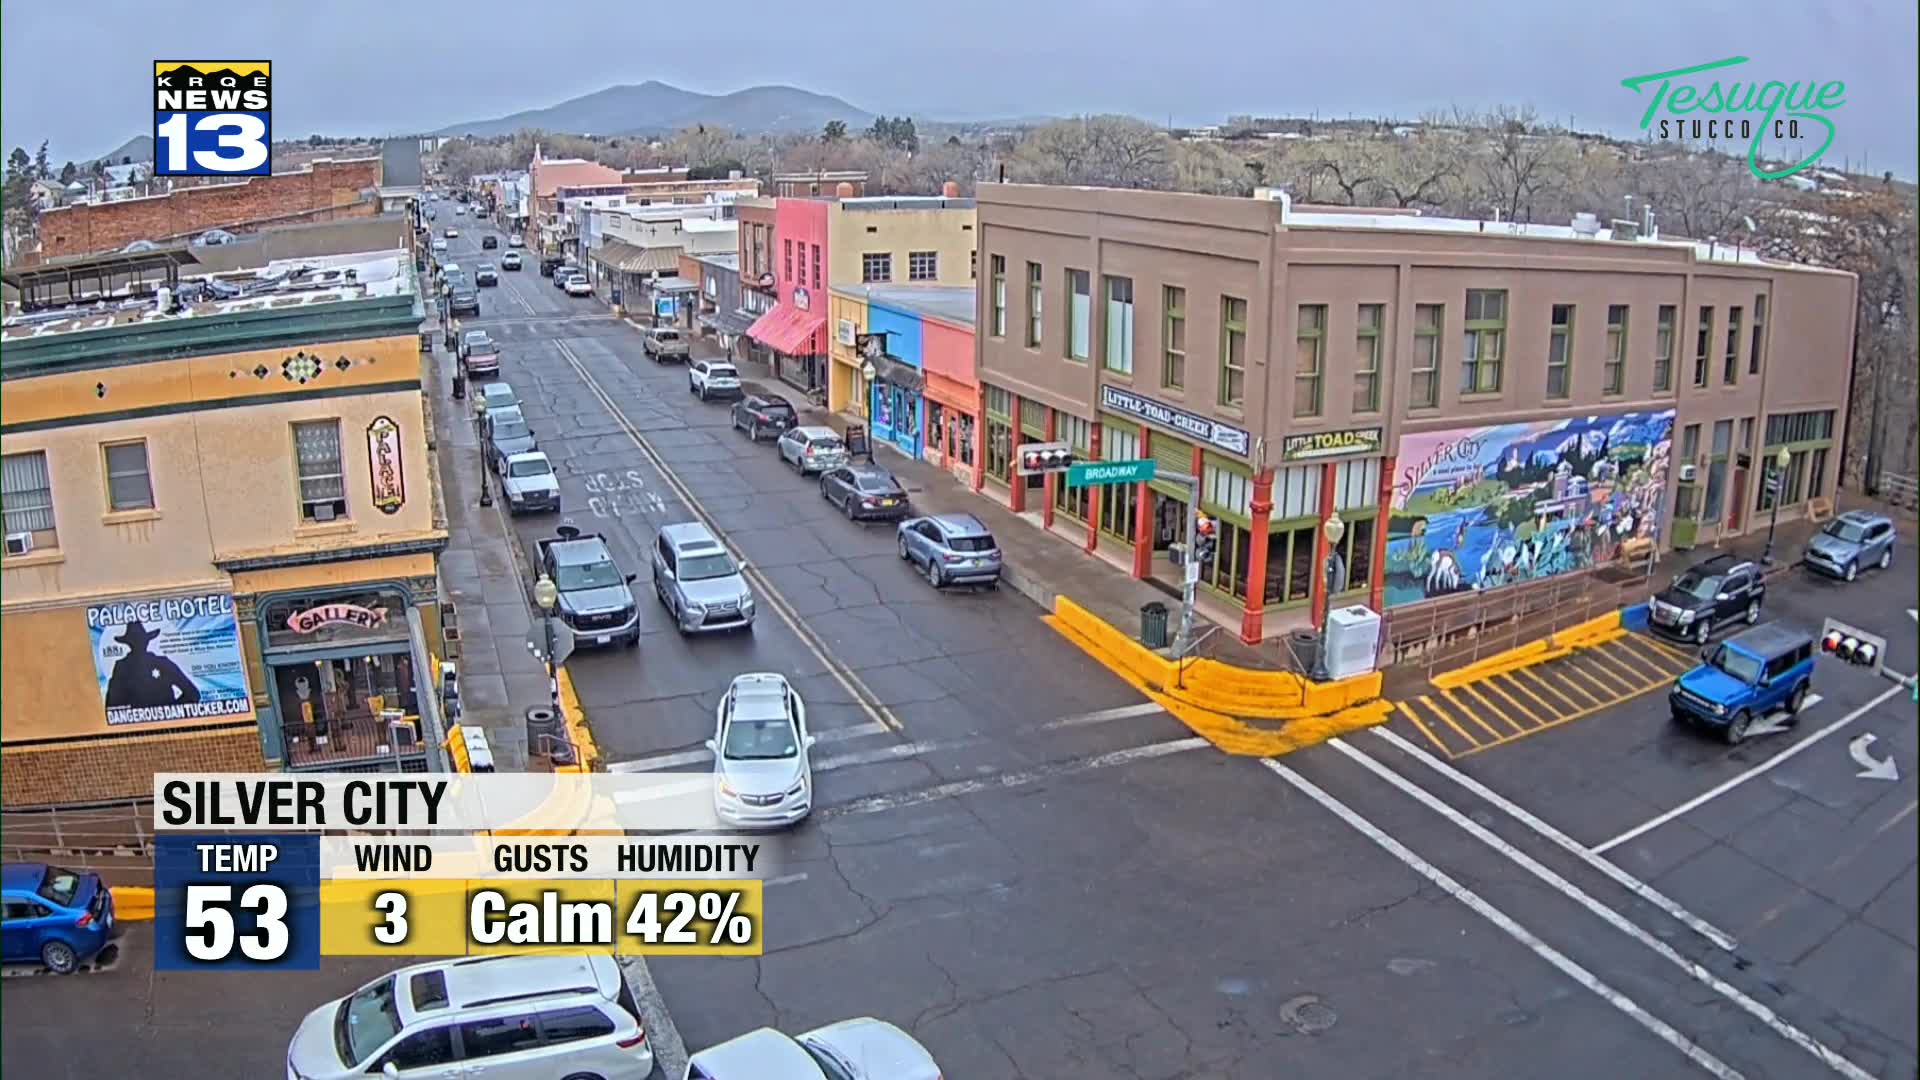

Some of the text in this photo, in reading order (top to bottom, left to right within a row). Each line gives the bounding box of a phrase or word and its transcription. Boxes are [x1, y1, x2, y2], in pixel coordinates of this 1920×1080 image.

[1315, 431, 1355, 448] TOAD
[1085, 465, 1138, 480] BROADWAY
[87, 595, 232, 628] PALACE HOTEL
[300, 608, 381, 630] GALLERY
[107, 698, 249, 725] DANGEROUSDANTUCKER.COM
